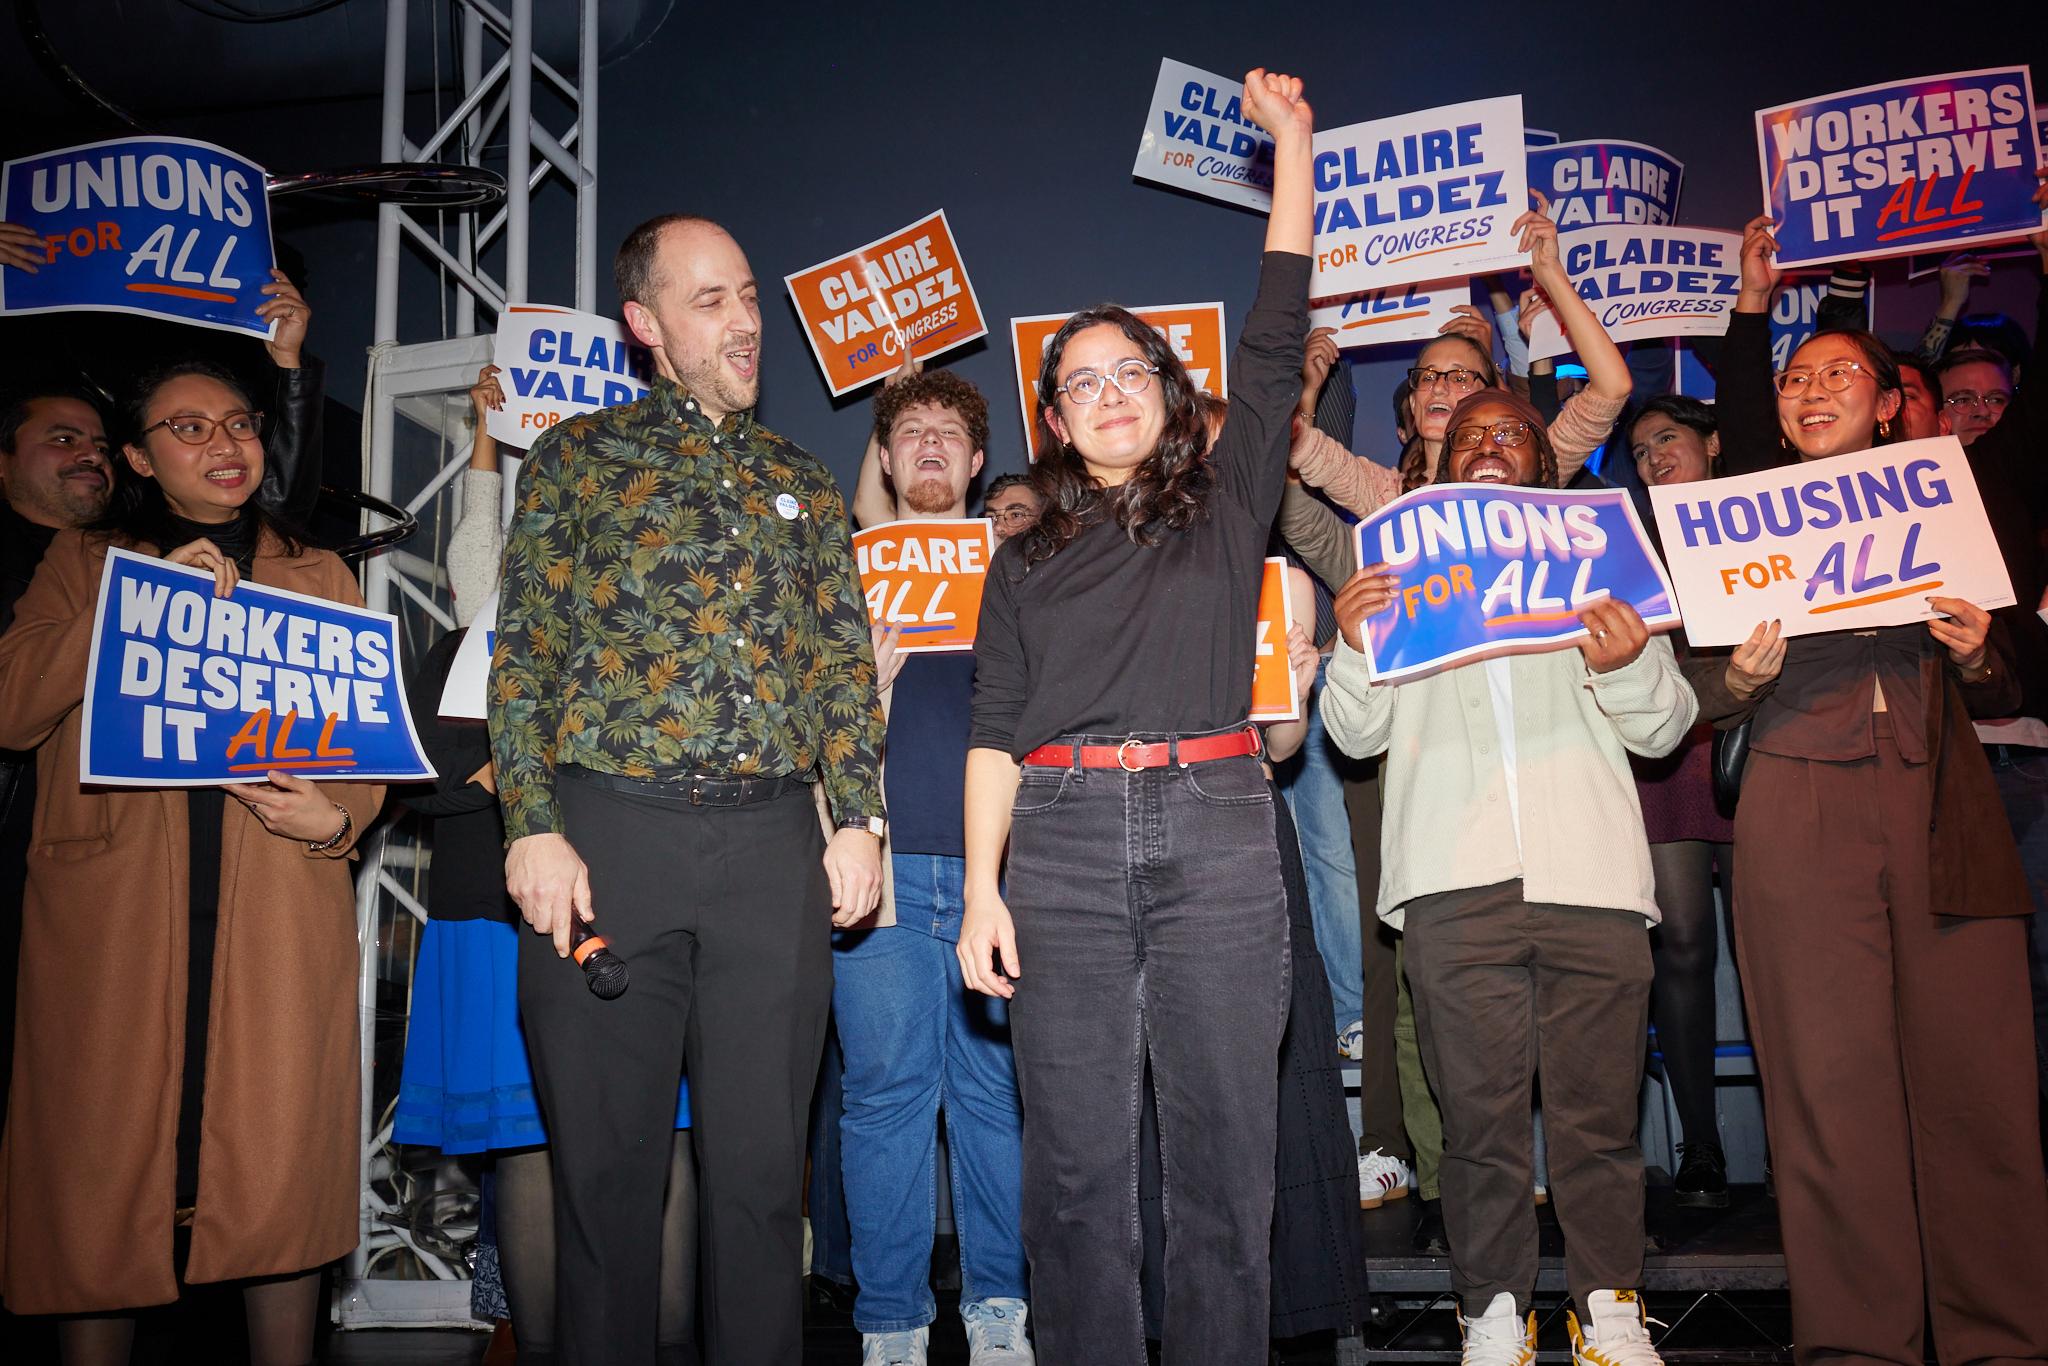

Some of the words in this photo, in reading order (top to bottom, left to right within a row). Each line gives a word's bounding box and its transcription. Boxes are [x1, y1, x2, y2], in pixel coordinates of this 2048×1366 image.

[1164, 110, 1276, 164] VALDE
[1180, 81, 1272, 136] CLA
[1772, 85, 2024, 161] WORKERS
[1163, 151, 1195, 168] FOR
[1313, 122, 1484, 193] CLAIRE
[1552, 156, 1670, 205] CLAIRE
[1787, 127, 2023, 202] DESERVE
[31, 154, 253, 228] UNIONS
[1811, 195, 1862, 242] IT
[1876, 164, 1984, 229] ALL
[45, 221, 122, 264] FOR
[125, 223, 241, 289] ALL
[819, 235, 939, 311] CLAIRE
[1318, 243, 1358, 272] FOR
[1364, 215, 1495, 266] CONGRESS
[1566, 238, 1724, 276] CLAIRE
[819, 267, 962, 345] VALDEZ
[1572, 270, 1741, 301] ALDEZ
[1602, 299, 1727, 328] CONGRESS
[528, 328, 651, 382] CLAIR
[848, 342, 880, 369] FOR
[882, 301, 958, 357] CONGRESS
[509, 367, 650, 408] VALD
[1379, 499, 1608, 567] UNIONS
[1675, 459, 1953, 547] HOUSING
[857, 537, 985, 576] ICARE
[1402, 563, 1476, 620] FOR
[1480, 557, 1611, 613] ALL
[1720, 554, 1797, 595] FOR
[1803, 522, 1941, 602] ALL
[120, 576, 390, 679] WORKERS
[865, 579, 957, 623] ALL
[120, 639, 390, 724] DESERVE
[143, 704, 207, 762] IT
[225, 707, 354, 760] ALL
